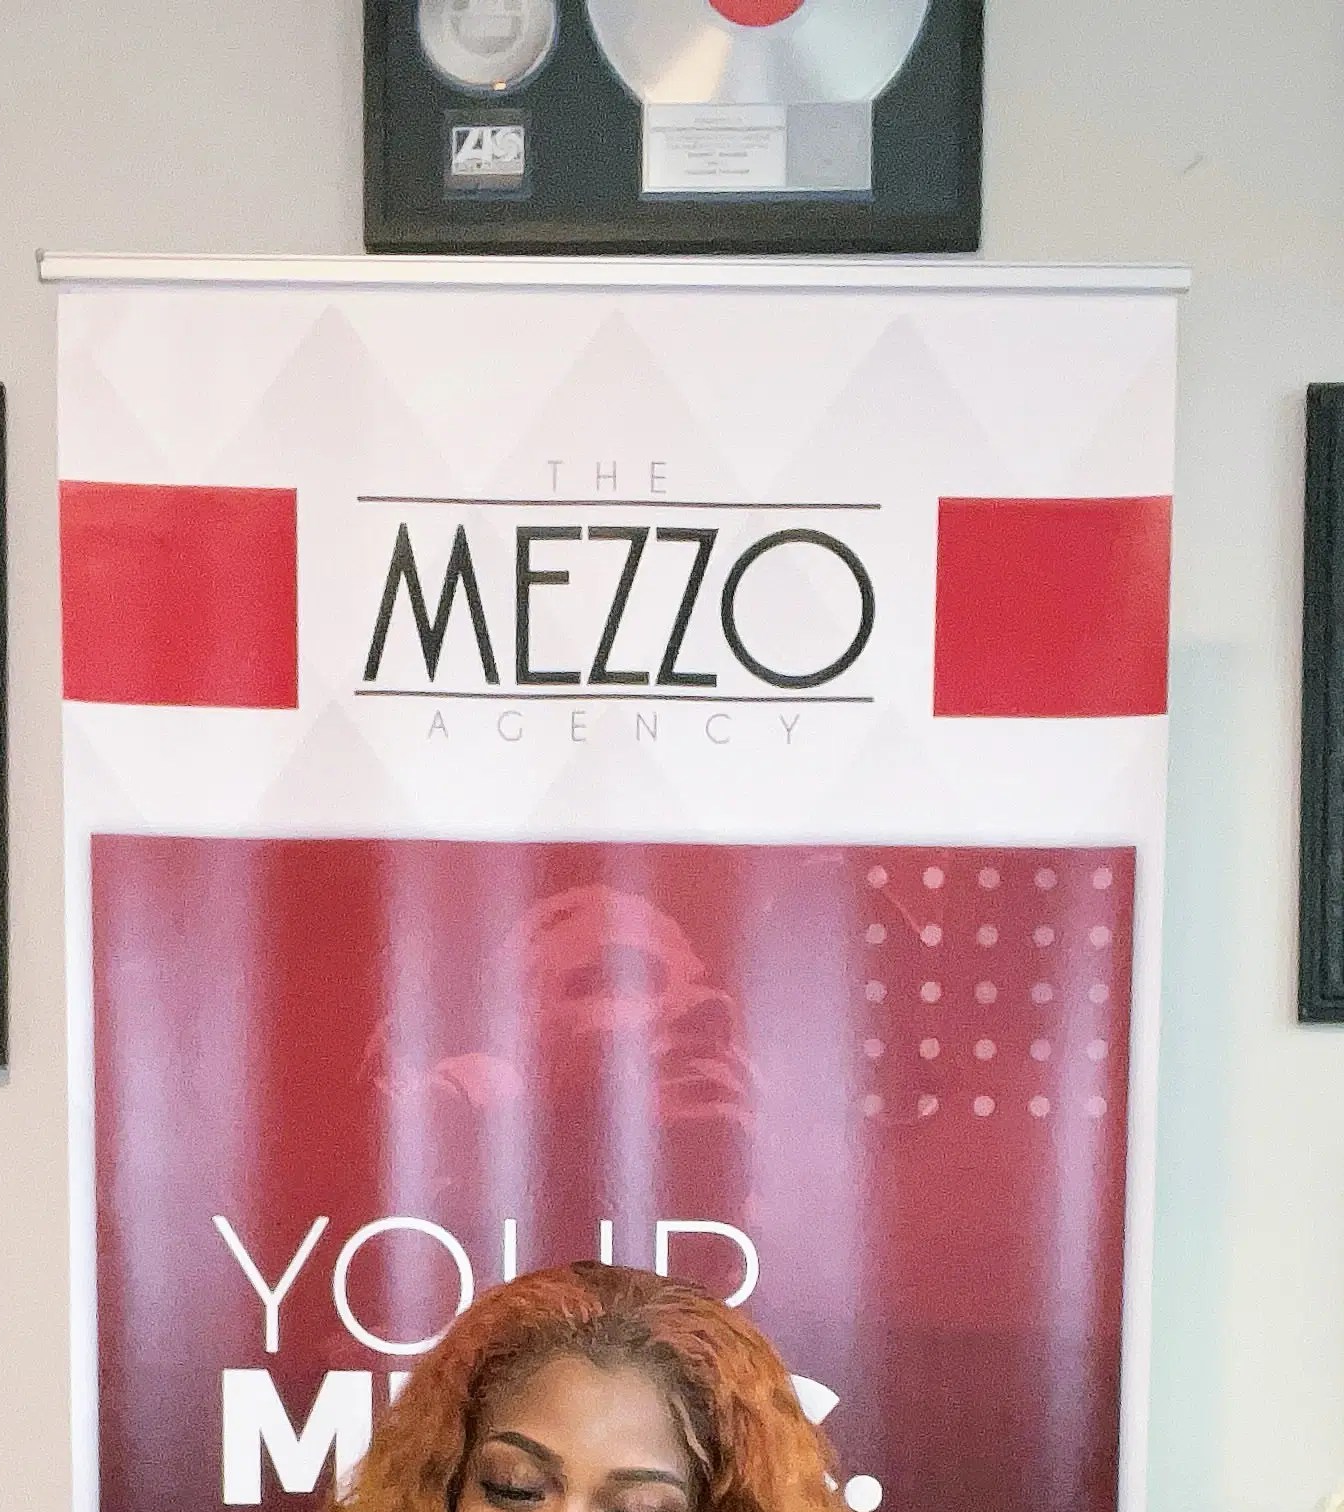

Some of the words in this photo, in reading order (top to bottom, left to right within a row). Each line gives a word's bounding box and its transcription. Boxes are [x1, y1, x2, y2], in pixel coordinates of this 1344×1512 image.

[547, 459, 667, 494] THE
[361, 523, 876, 689] MEZZO
[426, 709, 801, 745] AGENCY
